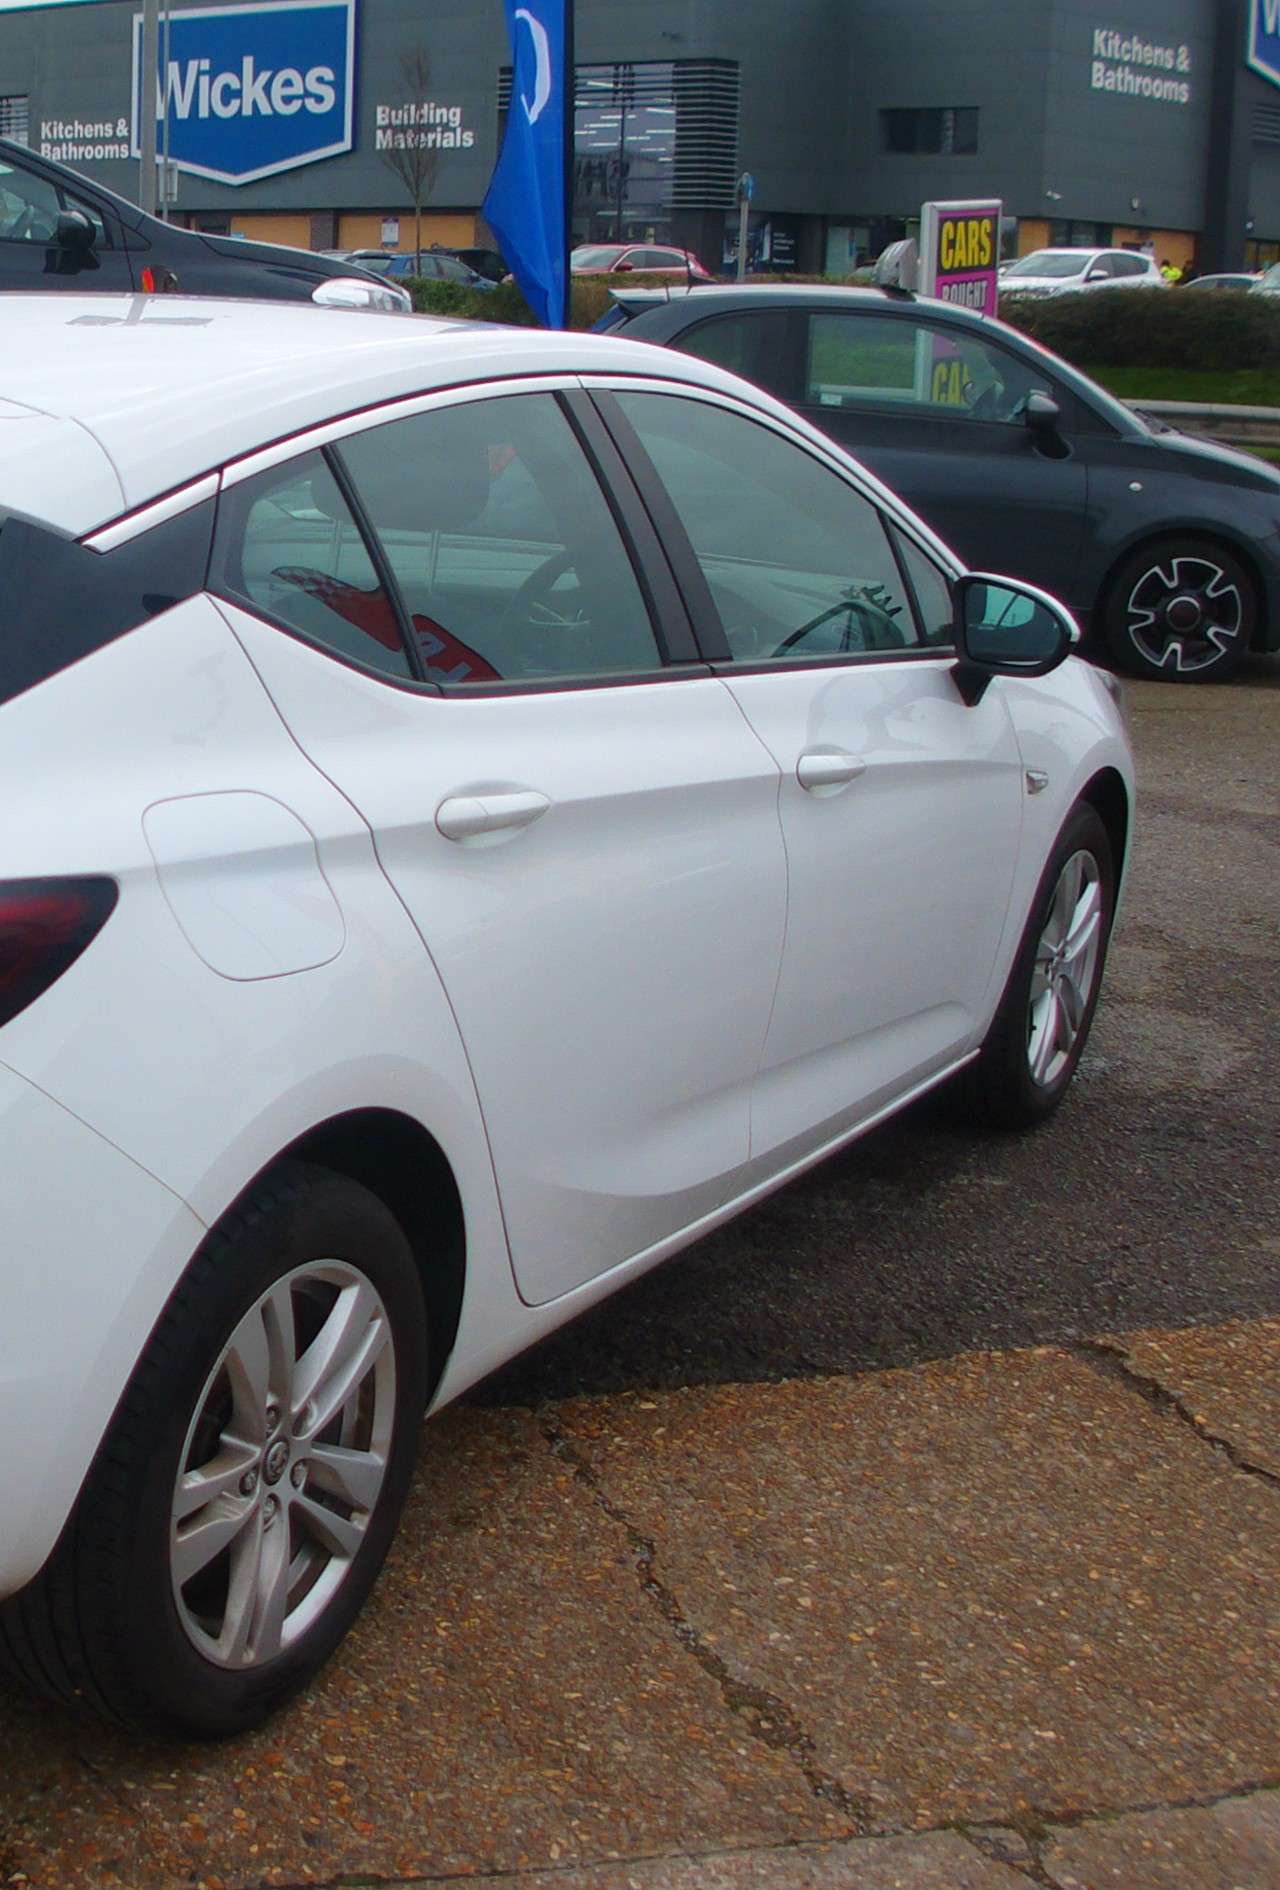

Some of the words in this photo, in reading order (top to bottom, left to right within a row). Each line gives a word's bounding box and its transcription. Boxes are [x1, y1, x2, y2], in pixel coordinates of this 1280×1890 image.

[1093, 29, 1175, 69] Kitchens
[1176, 44, 1191, 73] &
[155, 55, 336, 120] Wickes
[1091, 61, 1189, 103] Bathrooms
[40, 119, 113, 140] Kitchens
[116, 117, 129, 137] &
[376, 103, 462, 127] Building
[40, 140, 129, 161] Bathrooms
[375, 127, 475, 150] Materials
[940, 218, 992, 270] CARS
